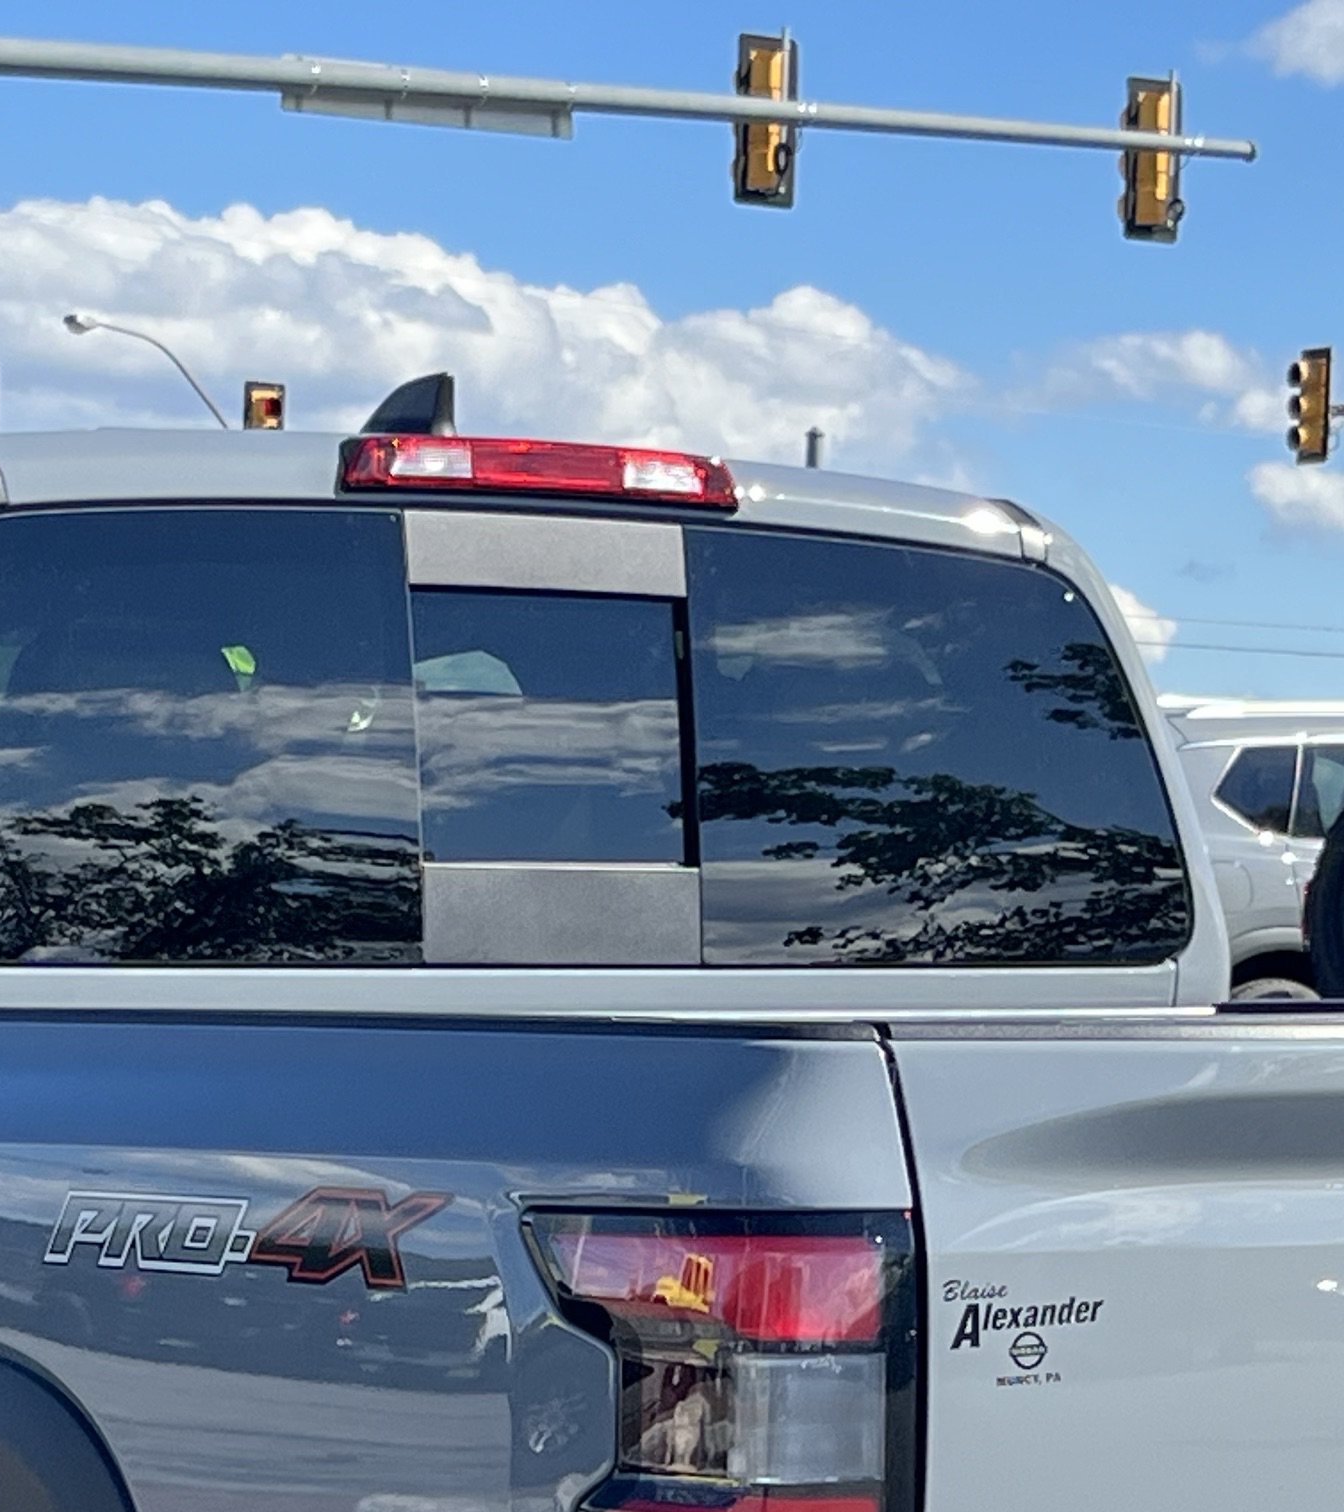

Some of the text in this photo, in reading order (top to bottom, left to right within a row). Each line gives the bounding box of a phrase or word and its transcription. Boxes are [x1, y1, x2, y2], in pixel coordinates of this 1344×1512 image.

[942, 1279, 1009, 1303] Blaise
[950, 1296, 1105, 1351] Alexander
[1046, 1372, 1062, 1382] PA
